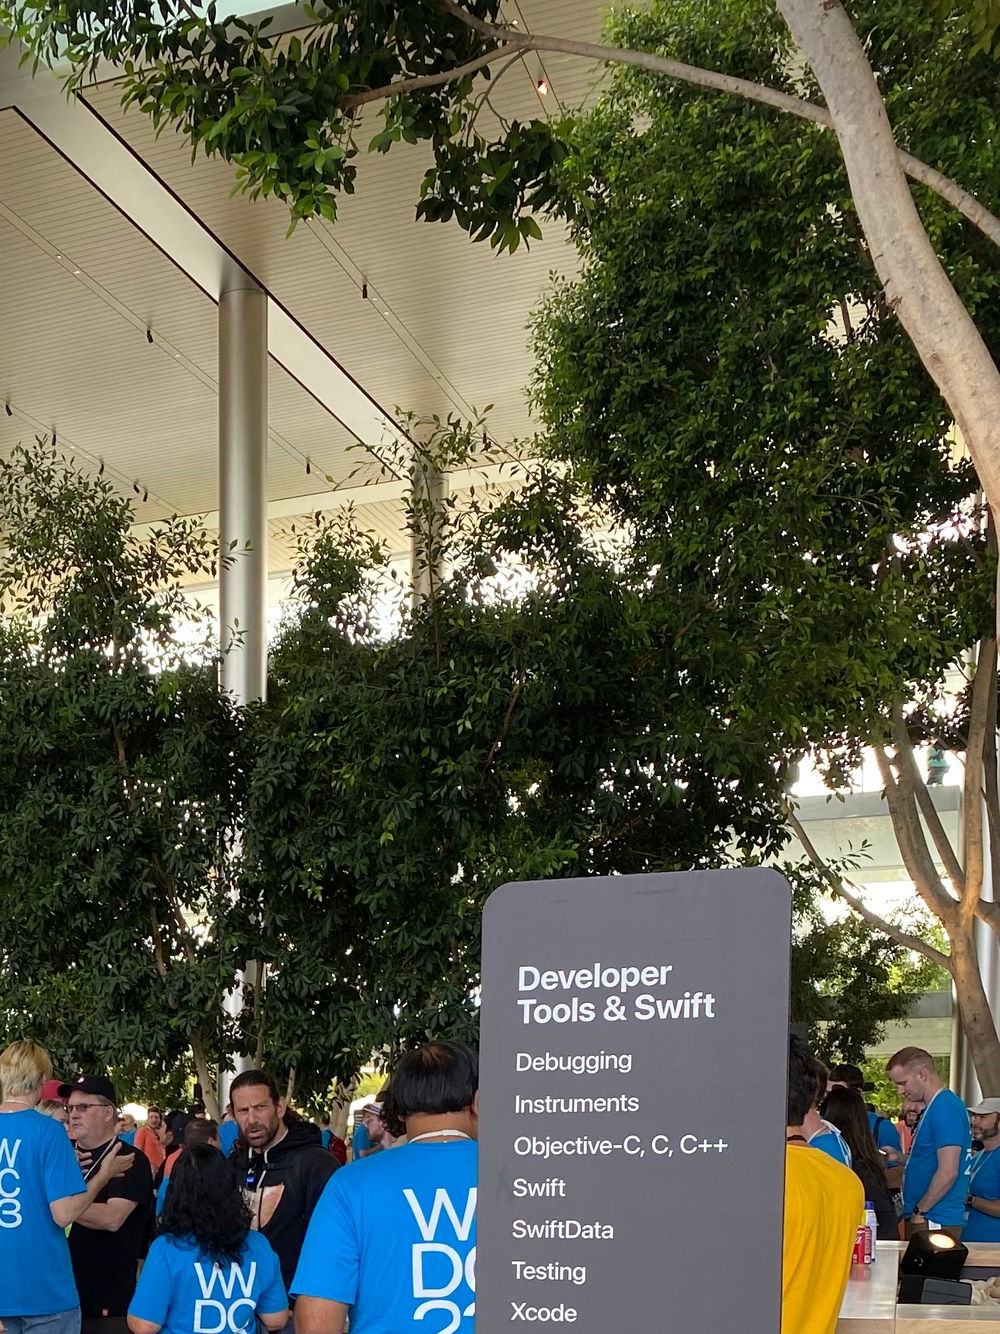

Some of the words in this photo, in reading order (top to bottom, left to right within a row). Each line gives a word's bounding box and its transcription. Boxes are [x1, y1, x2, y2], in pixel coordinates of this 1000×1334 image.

[518, 962, 673, 993] Developer
[516, 996, 596, 1025] Tools
[603, 995, 628, 1022] &
[634, 991, 716, 1021] Swift
[516, 1050, 632, 1075] Debugging
[515, 1094, 640, 1114] Instruments
[514, 1135, 645, 1159] Objective-C,
[651, 1134, 674, 1158] C,
[680, 1134, 728, 1155] C++
[512, 1177, 567, 1198] Swift
[512, 1219, 614, 1240] SwiftData
[412, 1243, 477, 1298] D
[511, 1260, 587, 1285] Testing
[510, 1302, 578, 1323] Xcode
